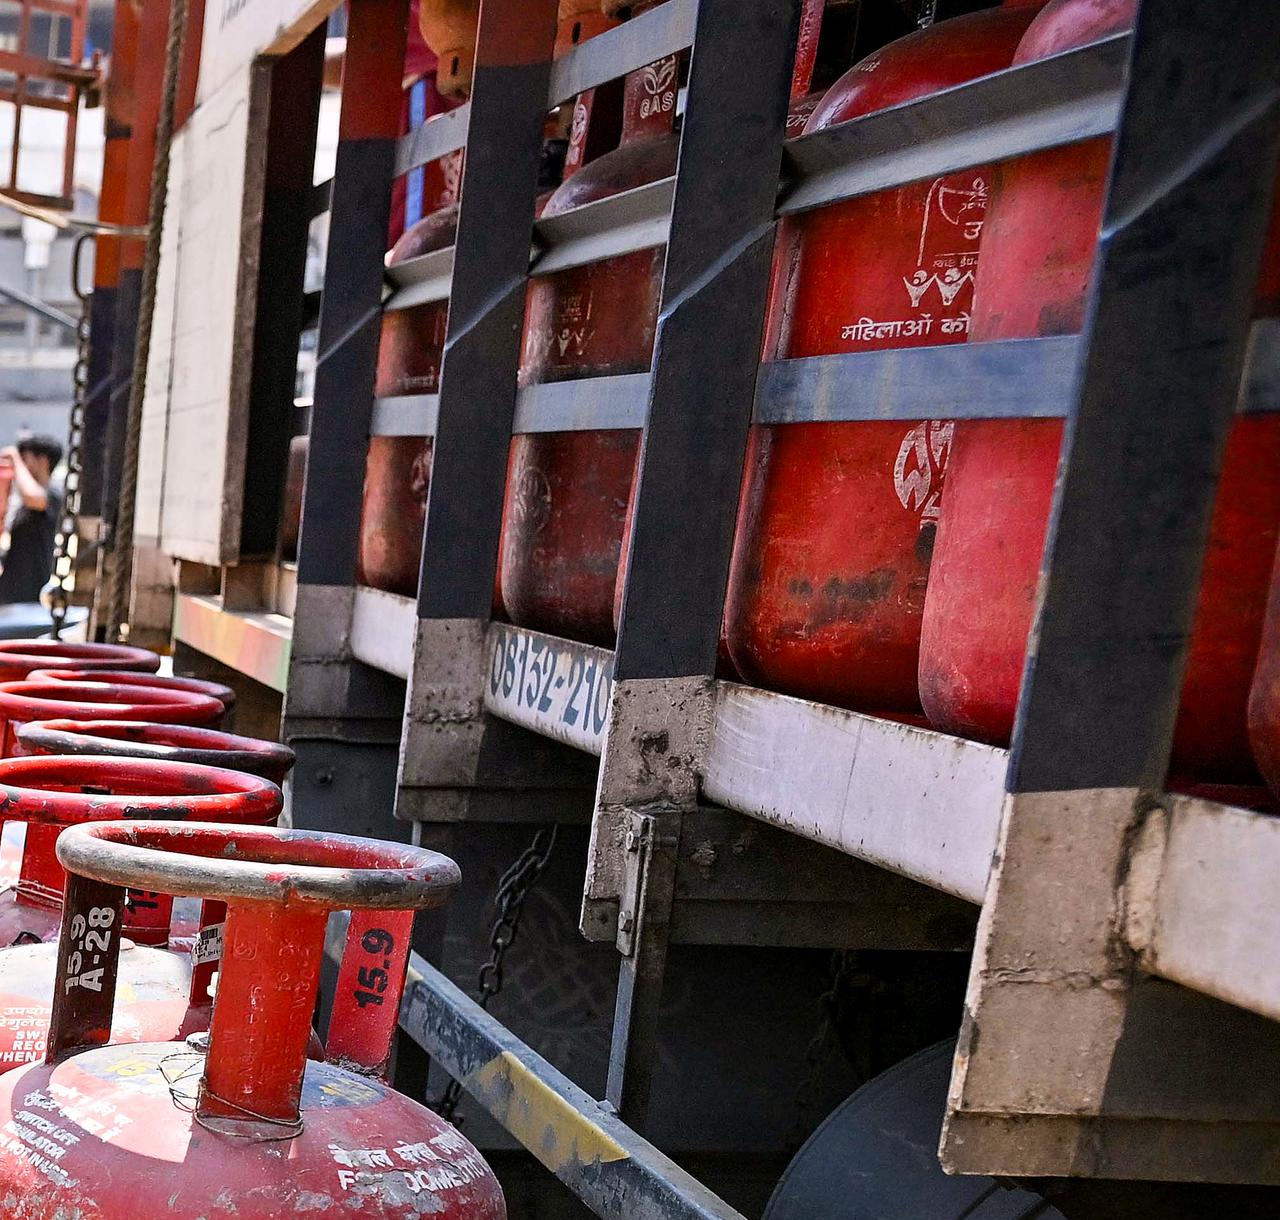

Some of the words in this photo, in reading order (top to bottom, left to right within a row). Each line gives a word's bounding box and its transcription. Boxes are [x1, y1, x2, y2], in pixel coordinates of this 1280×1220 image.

[639, 90, 675, 119] GAS
[65, 914, 86, 995] 15.9
[79, 907, 115, 992] A-28
[353, 928, 394, 1009] 15.9
